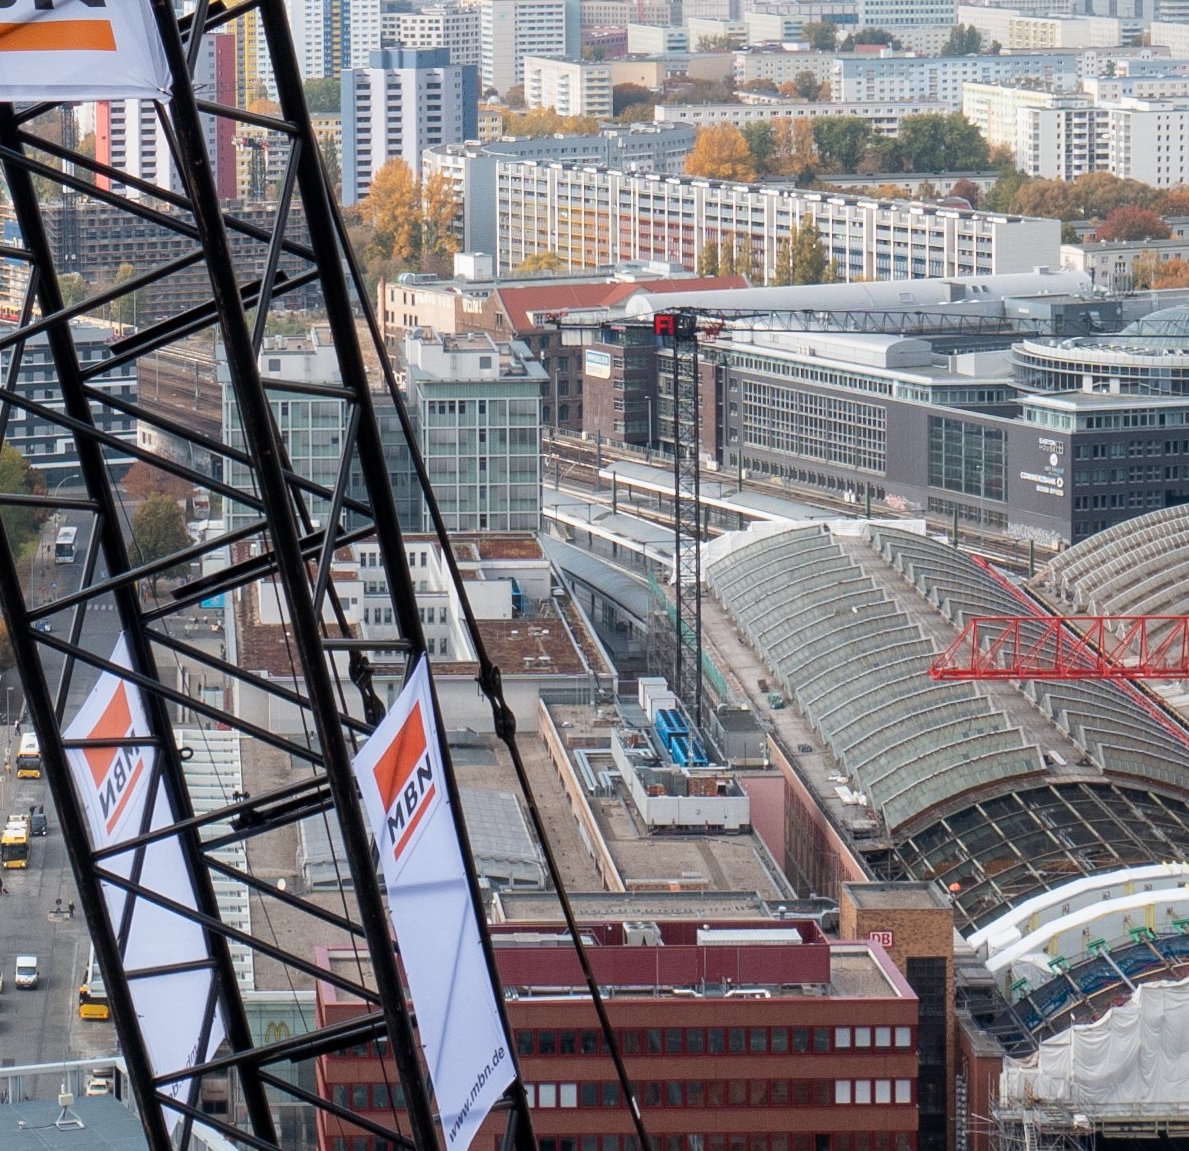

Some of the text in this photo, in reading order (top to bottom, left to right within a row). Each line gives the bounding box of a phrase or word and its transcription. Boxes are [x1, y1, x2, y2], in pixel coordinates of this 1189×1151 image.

[387, 752, 433, 845] MBN
[872, 933, 891, 945] DB
[449, 1046, 505, 1143] www.mbn.de
